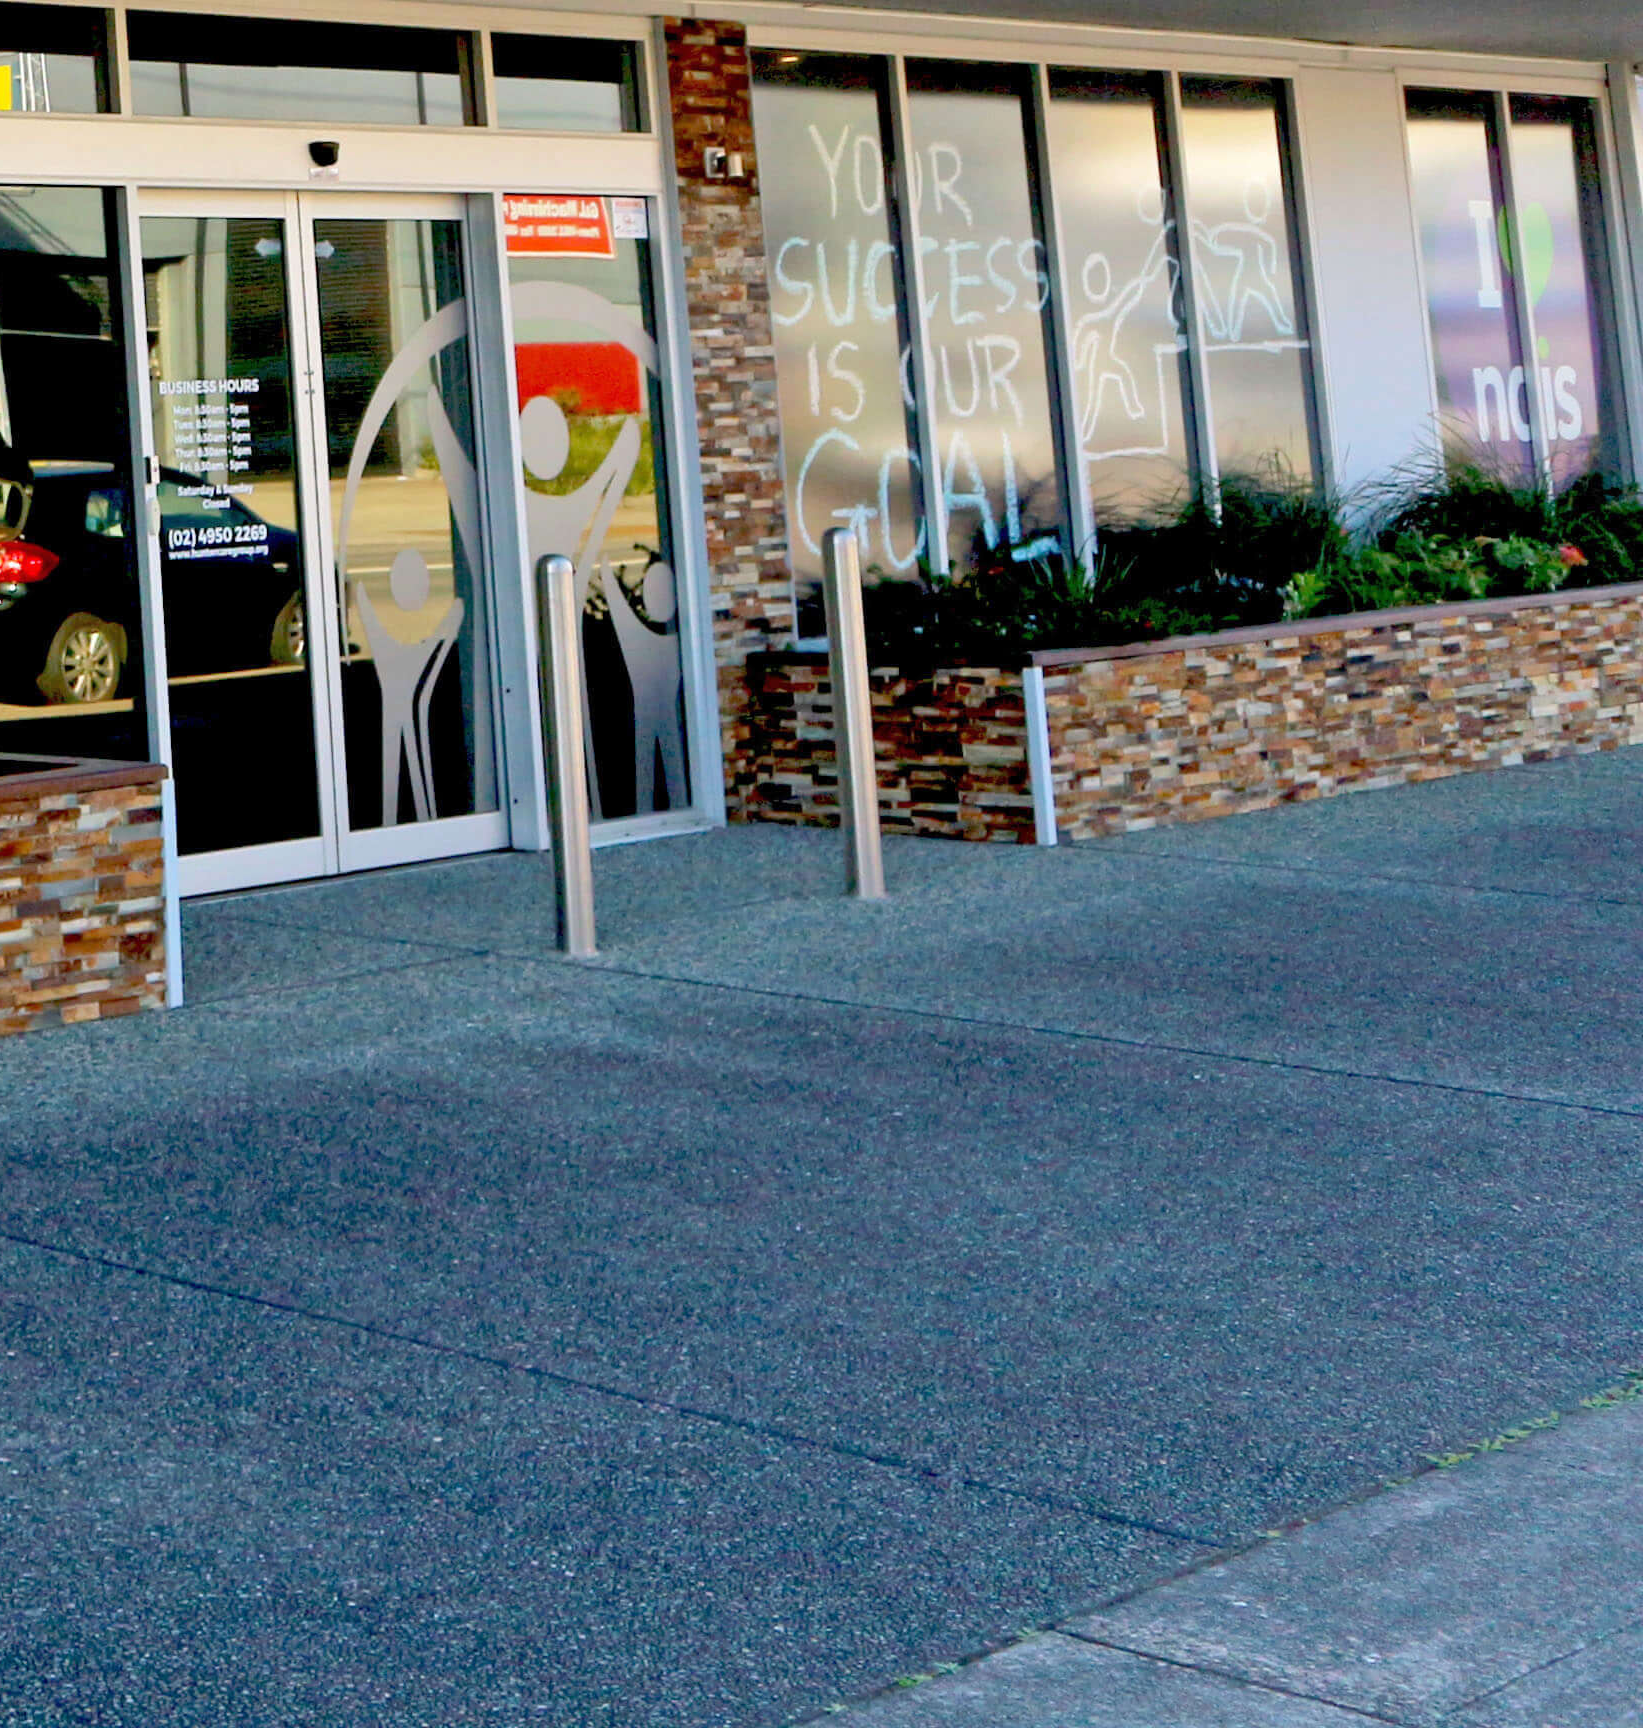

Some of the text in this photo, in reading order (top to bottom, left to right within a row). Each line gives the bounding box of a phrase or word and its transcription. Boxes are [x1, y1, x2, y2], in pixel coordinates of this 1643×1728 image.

[1468, 200, 1503, 309] I
[159, 378, 260, 395] BUSINESS HOURS
[808, 340, 865, 422] IS
[168, 523, 268, 550] (02) 4950 2269
[796, 428, 1061, 570] GOAL
